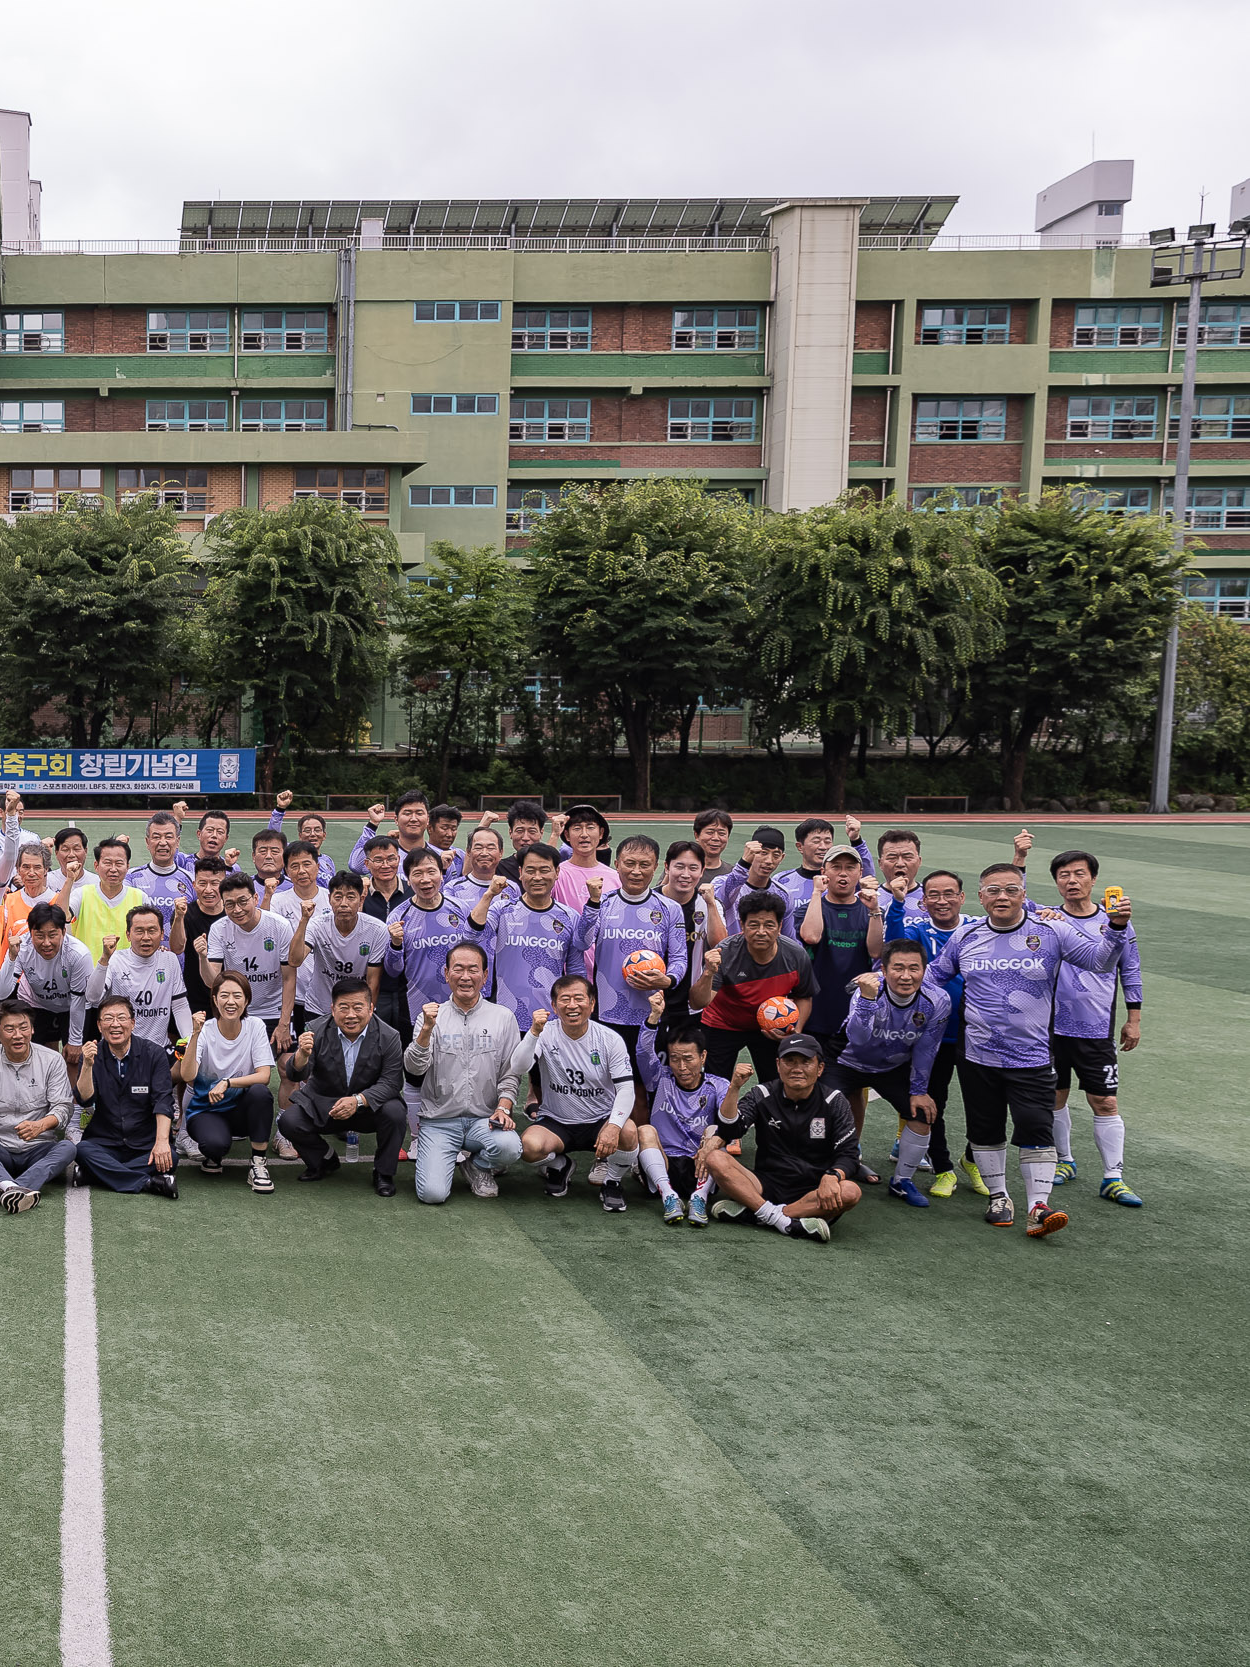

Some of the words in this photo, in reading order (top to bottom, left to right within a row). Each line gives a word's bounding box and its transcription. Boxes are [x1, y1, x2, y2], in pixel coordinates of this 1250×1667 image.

[79, 753, 198, 777] 창립기념일
[602, 928, 662, 942] JUNGGOK
[505, 935, 565, 951] JUNGGOK
[242, 956, 258, 972] 14
[335, 960, 353, 974] 38
[969, 958, 1046, 970] JUNGGOK
[270, 971, 278, 980] FC
[43, 978, 58, 993] 46
[136, 990, 152, 1006] 40
[136, 1008, 158, 1018] MOON
[158, 1007, 168, 1016] FC
[872, 1028, 924, 1040] UNGGOK
[566, 1068, 584, 1086] 33
